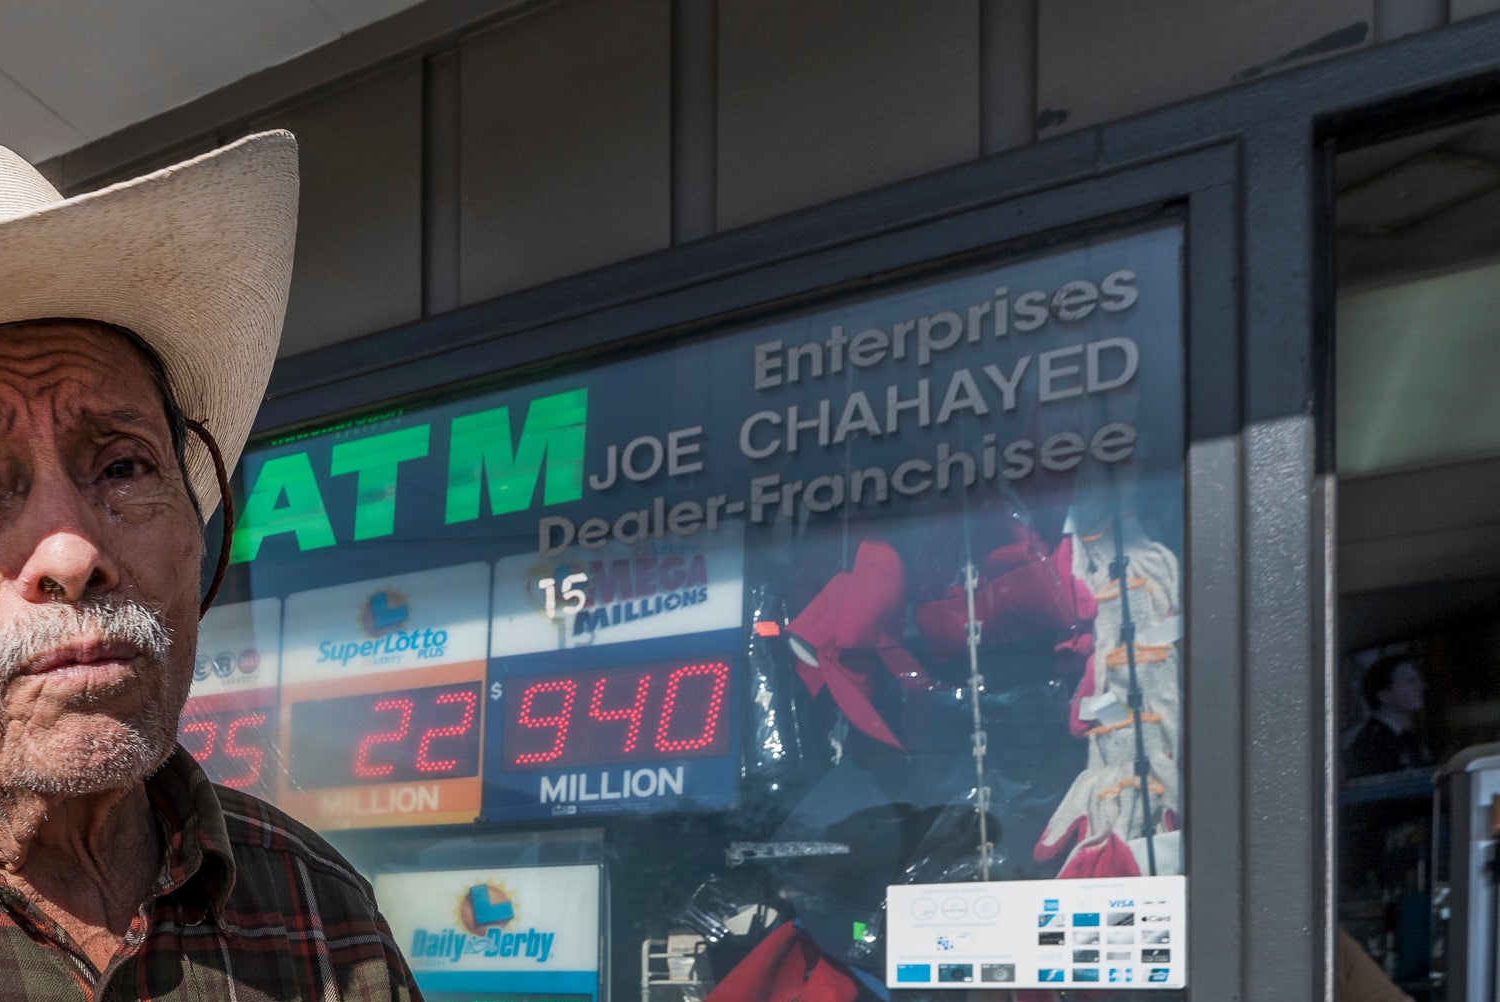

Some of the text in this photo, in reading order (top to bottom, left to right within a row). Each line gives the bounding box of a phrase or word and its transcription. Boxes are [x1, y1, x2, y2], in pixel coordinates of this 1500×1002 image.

[755, 269, 1139, 389] Enterprises
[589, 336, 1140, 490] JOE CHAHAYED
[229, 388, 588, 565] ATM
[539, 421, 1137, 558] Dealer-Franchisee
[539, 572, 588, 619] 15
[585, 555, 709, 606] MEGA
[574, 587, 708, 636] MILLIONS
[317, 629, 448, 666] SuperLotto
[417, 646, 445, 660] PLUS
[356, 691, 478, 777] 22
[490, 662, 730, 764] $ 940
[321, 786, 440, 816] MILLION
[540, 766, 684, 804] MILLION
[1109, 900, 1134, 908] VISA
[411, 928, 555, 963] Daily Derby
